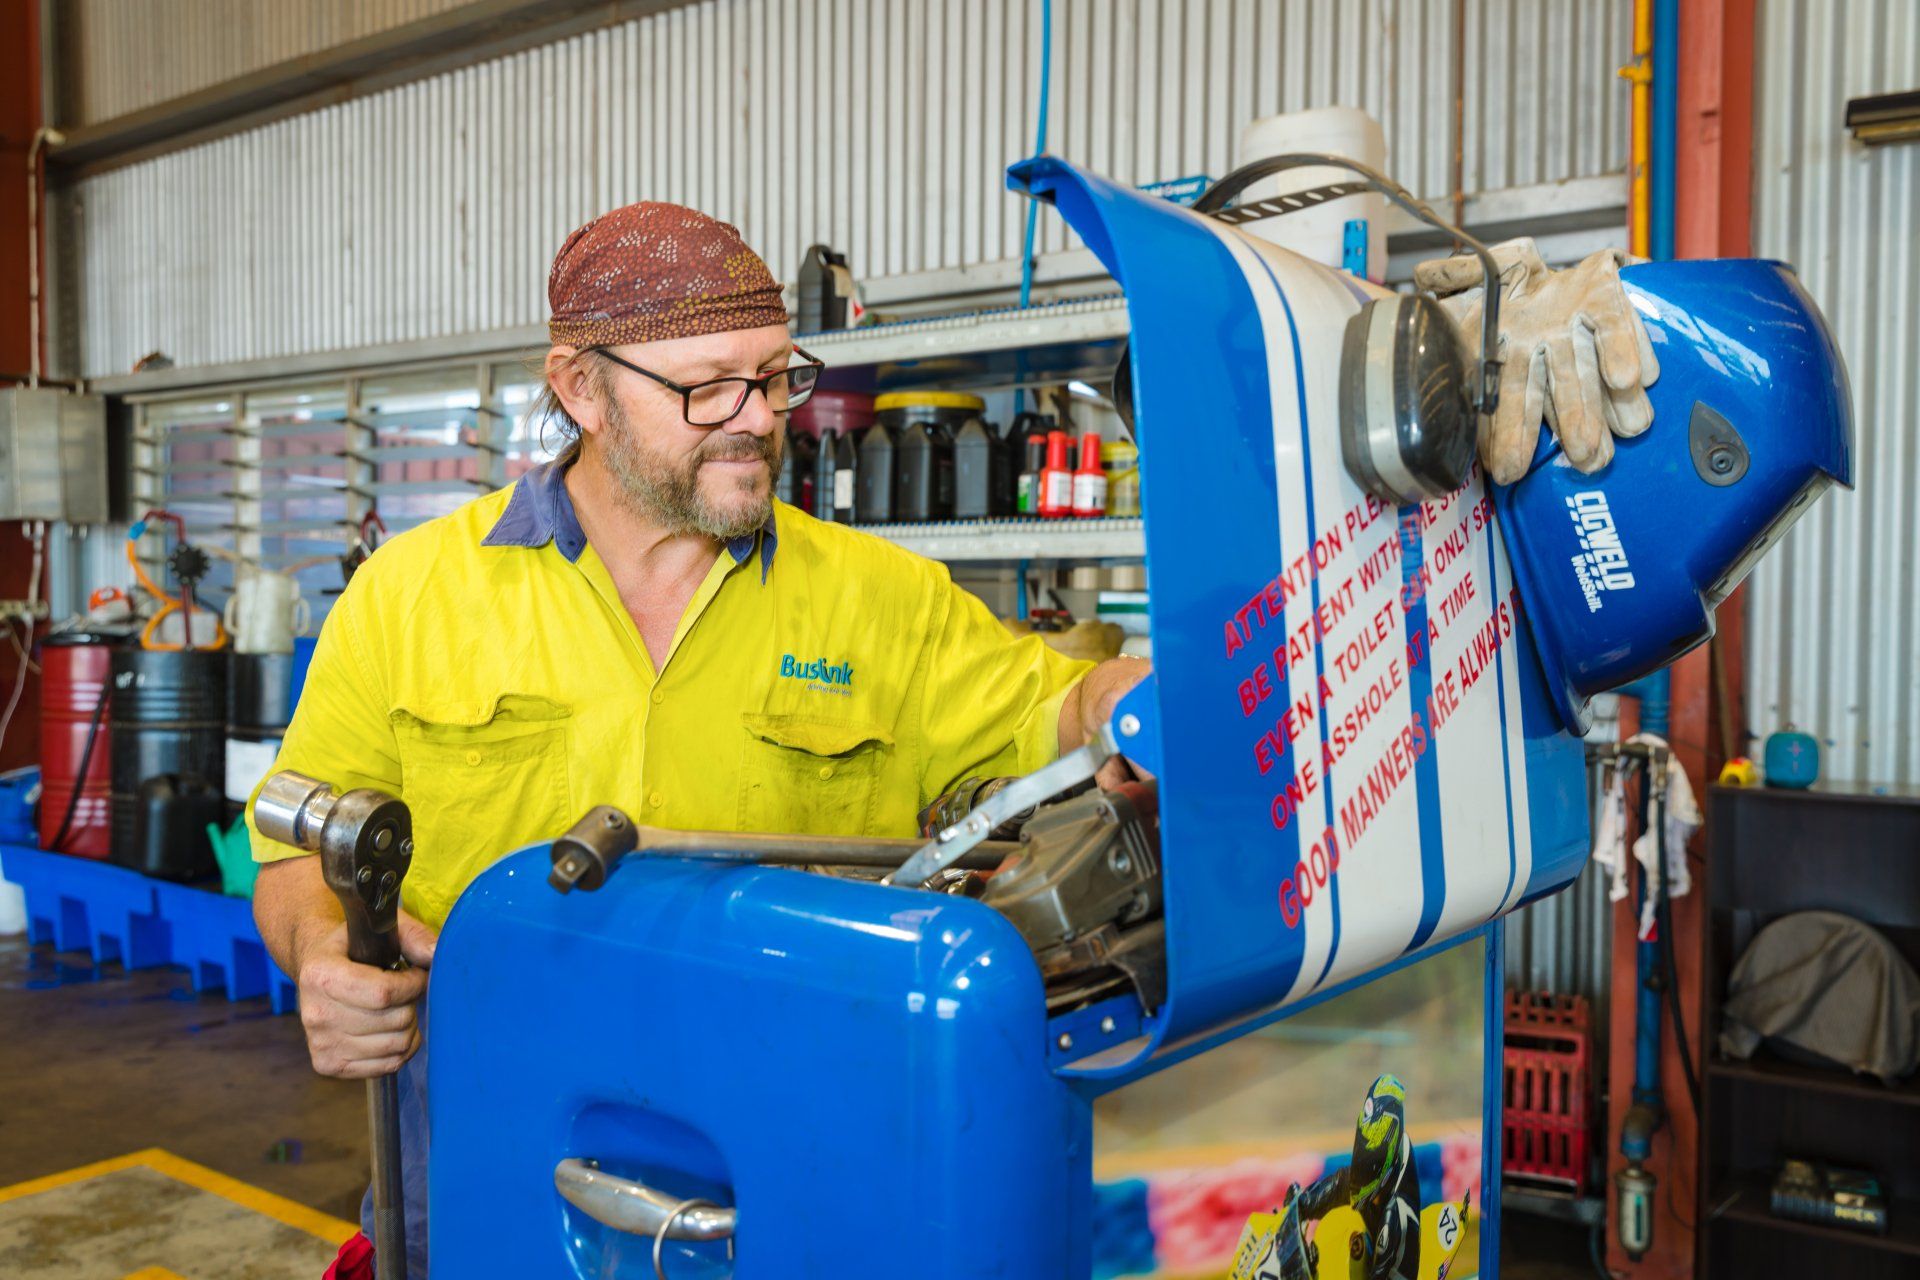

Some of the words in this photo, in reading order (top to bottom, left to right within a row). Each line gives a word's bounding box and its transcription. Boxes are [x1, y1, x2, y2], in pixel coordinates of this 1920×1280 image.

[1223, 524, 1341, 659] ATTENTION
[1345, 492, 1390, 541] PLEA
[1238, 662, 1273, 717] BE
[1273, 578, 1355, 681] PATIENT
[1358, 530, 1403, 593] WITH
[1403, 501, 1437, 544] THE
[1255, 692, 1313, 775] EVEN
[1318, 674, 1332, 708] A
[1334, 600, 1395, 684] TOILET
[1400, 561, 1432, 613] CAN
[1434, 516, 1469, 574] ONLY
[1574, 490, 1635, 591] CIGWELD
[1271, 760, 1317, 829] ONE
[1322, 658, 1402, 776] ASSHOLE
[1406, 630, 1423, 673] AT
[1428, 617, 1440, 646] A
[1440, 571, 1475, 627] TIME
[1279, 826, 1340, 929] GOOD
[1340, 711, 1427, 849] MANNERS
[1426, 670, 1459, 739] ARE
[1459, 601, 1511, 696] ALWAYS
